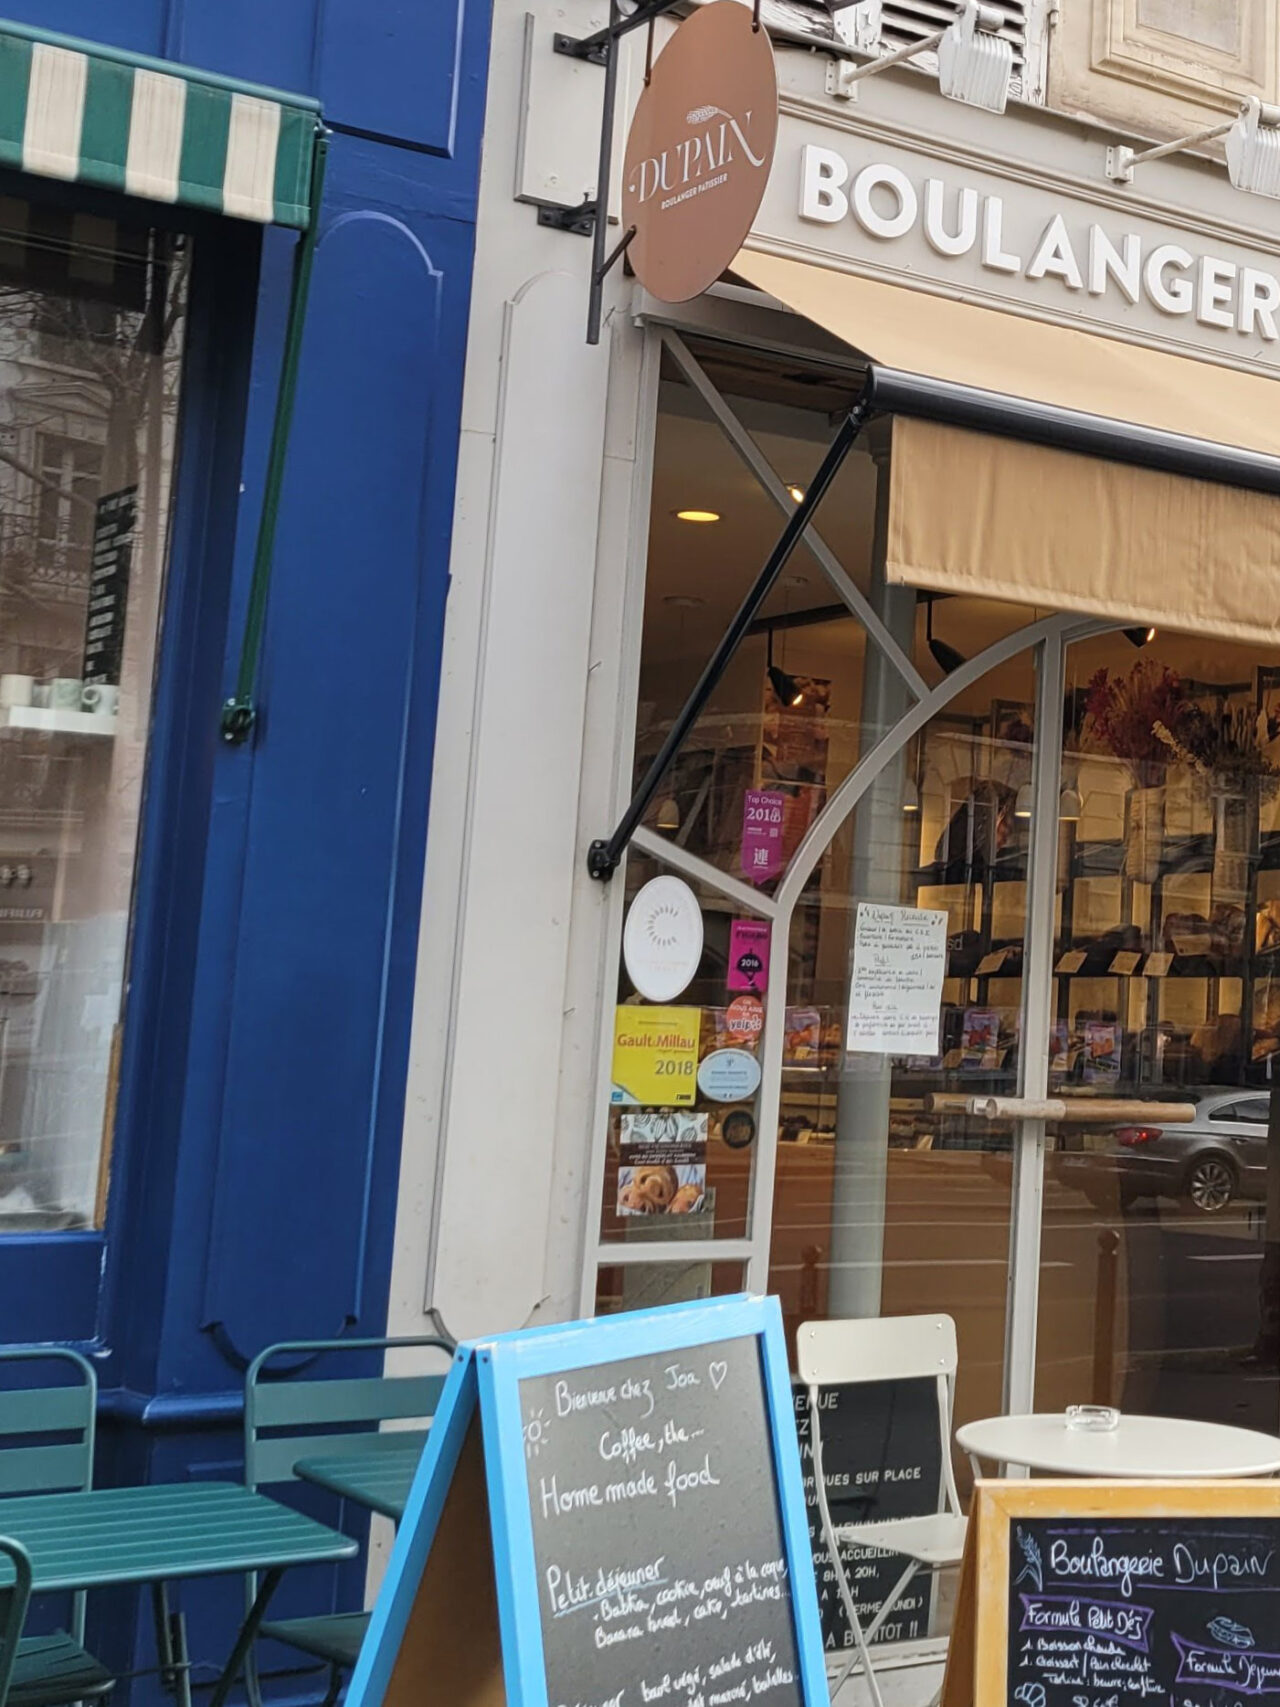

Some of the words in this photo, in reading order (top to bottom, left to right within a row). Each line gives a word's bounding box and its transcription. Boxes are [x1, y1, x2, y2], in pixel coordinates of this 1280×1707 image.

[628, 110, 766, 203] DUPAIN
[660, 186, 697, 210] BOULANGER
[729, 1019, 752, 1032] yelp
[655, 1060, 694, 1076] 2018
[855, 1470, 880, 1485] SUR
[884, 1466, 921, 1481] PLACE
[540, 1474, 604, 1519] Home
[605, 1469, 658, 1503] made
[664, 1453, 720, 1509] food
[825, 1631, 836, 1648] A
